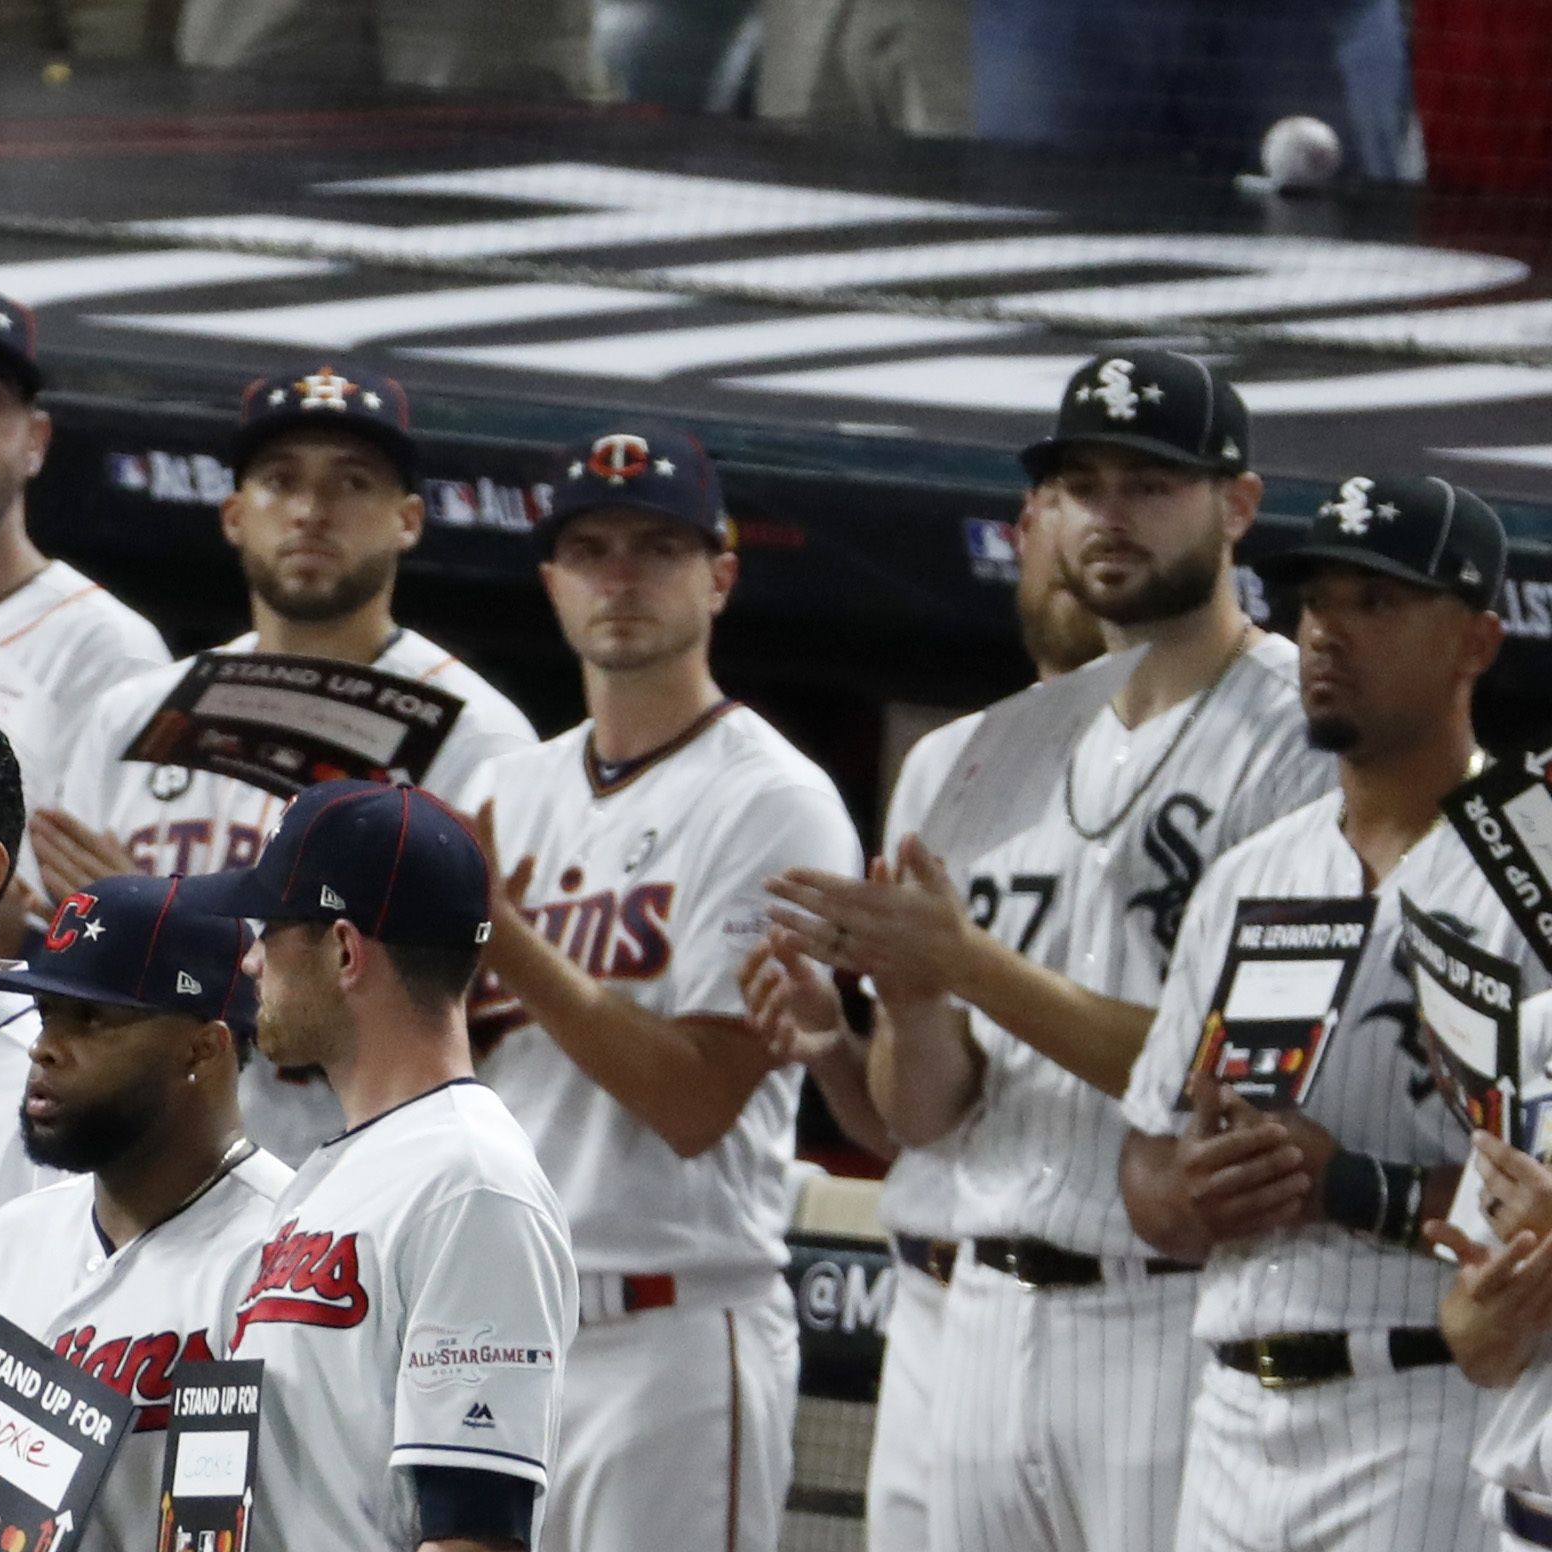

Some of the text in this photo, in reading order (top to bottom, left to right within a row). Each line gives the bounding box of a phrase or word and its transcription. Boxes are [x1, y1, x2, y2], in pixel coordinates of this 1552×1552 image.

[216, 659, 323, 688] STAND
[326, 673, 375, 699] UP
[376, 685, 445, 728] FOR
[1464, 792, 1542, 909] FOR UP
[46, 893, 97, 951] C
[39, 1380, 73, 1417] UP
[68, 1399, 113, 1447] FOR
[173, 1385, 259, 1417] I STAND UP FOR
